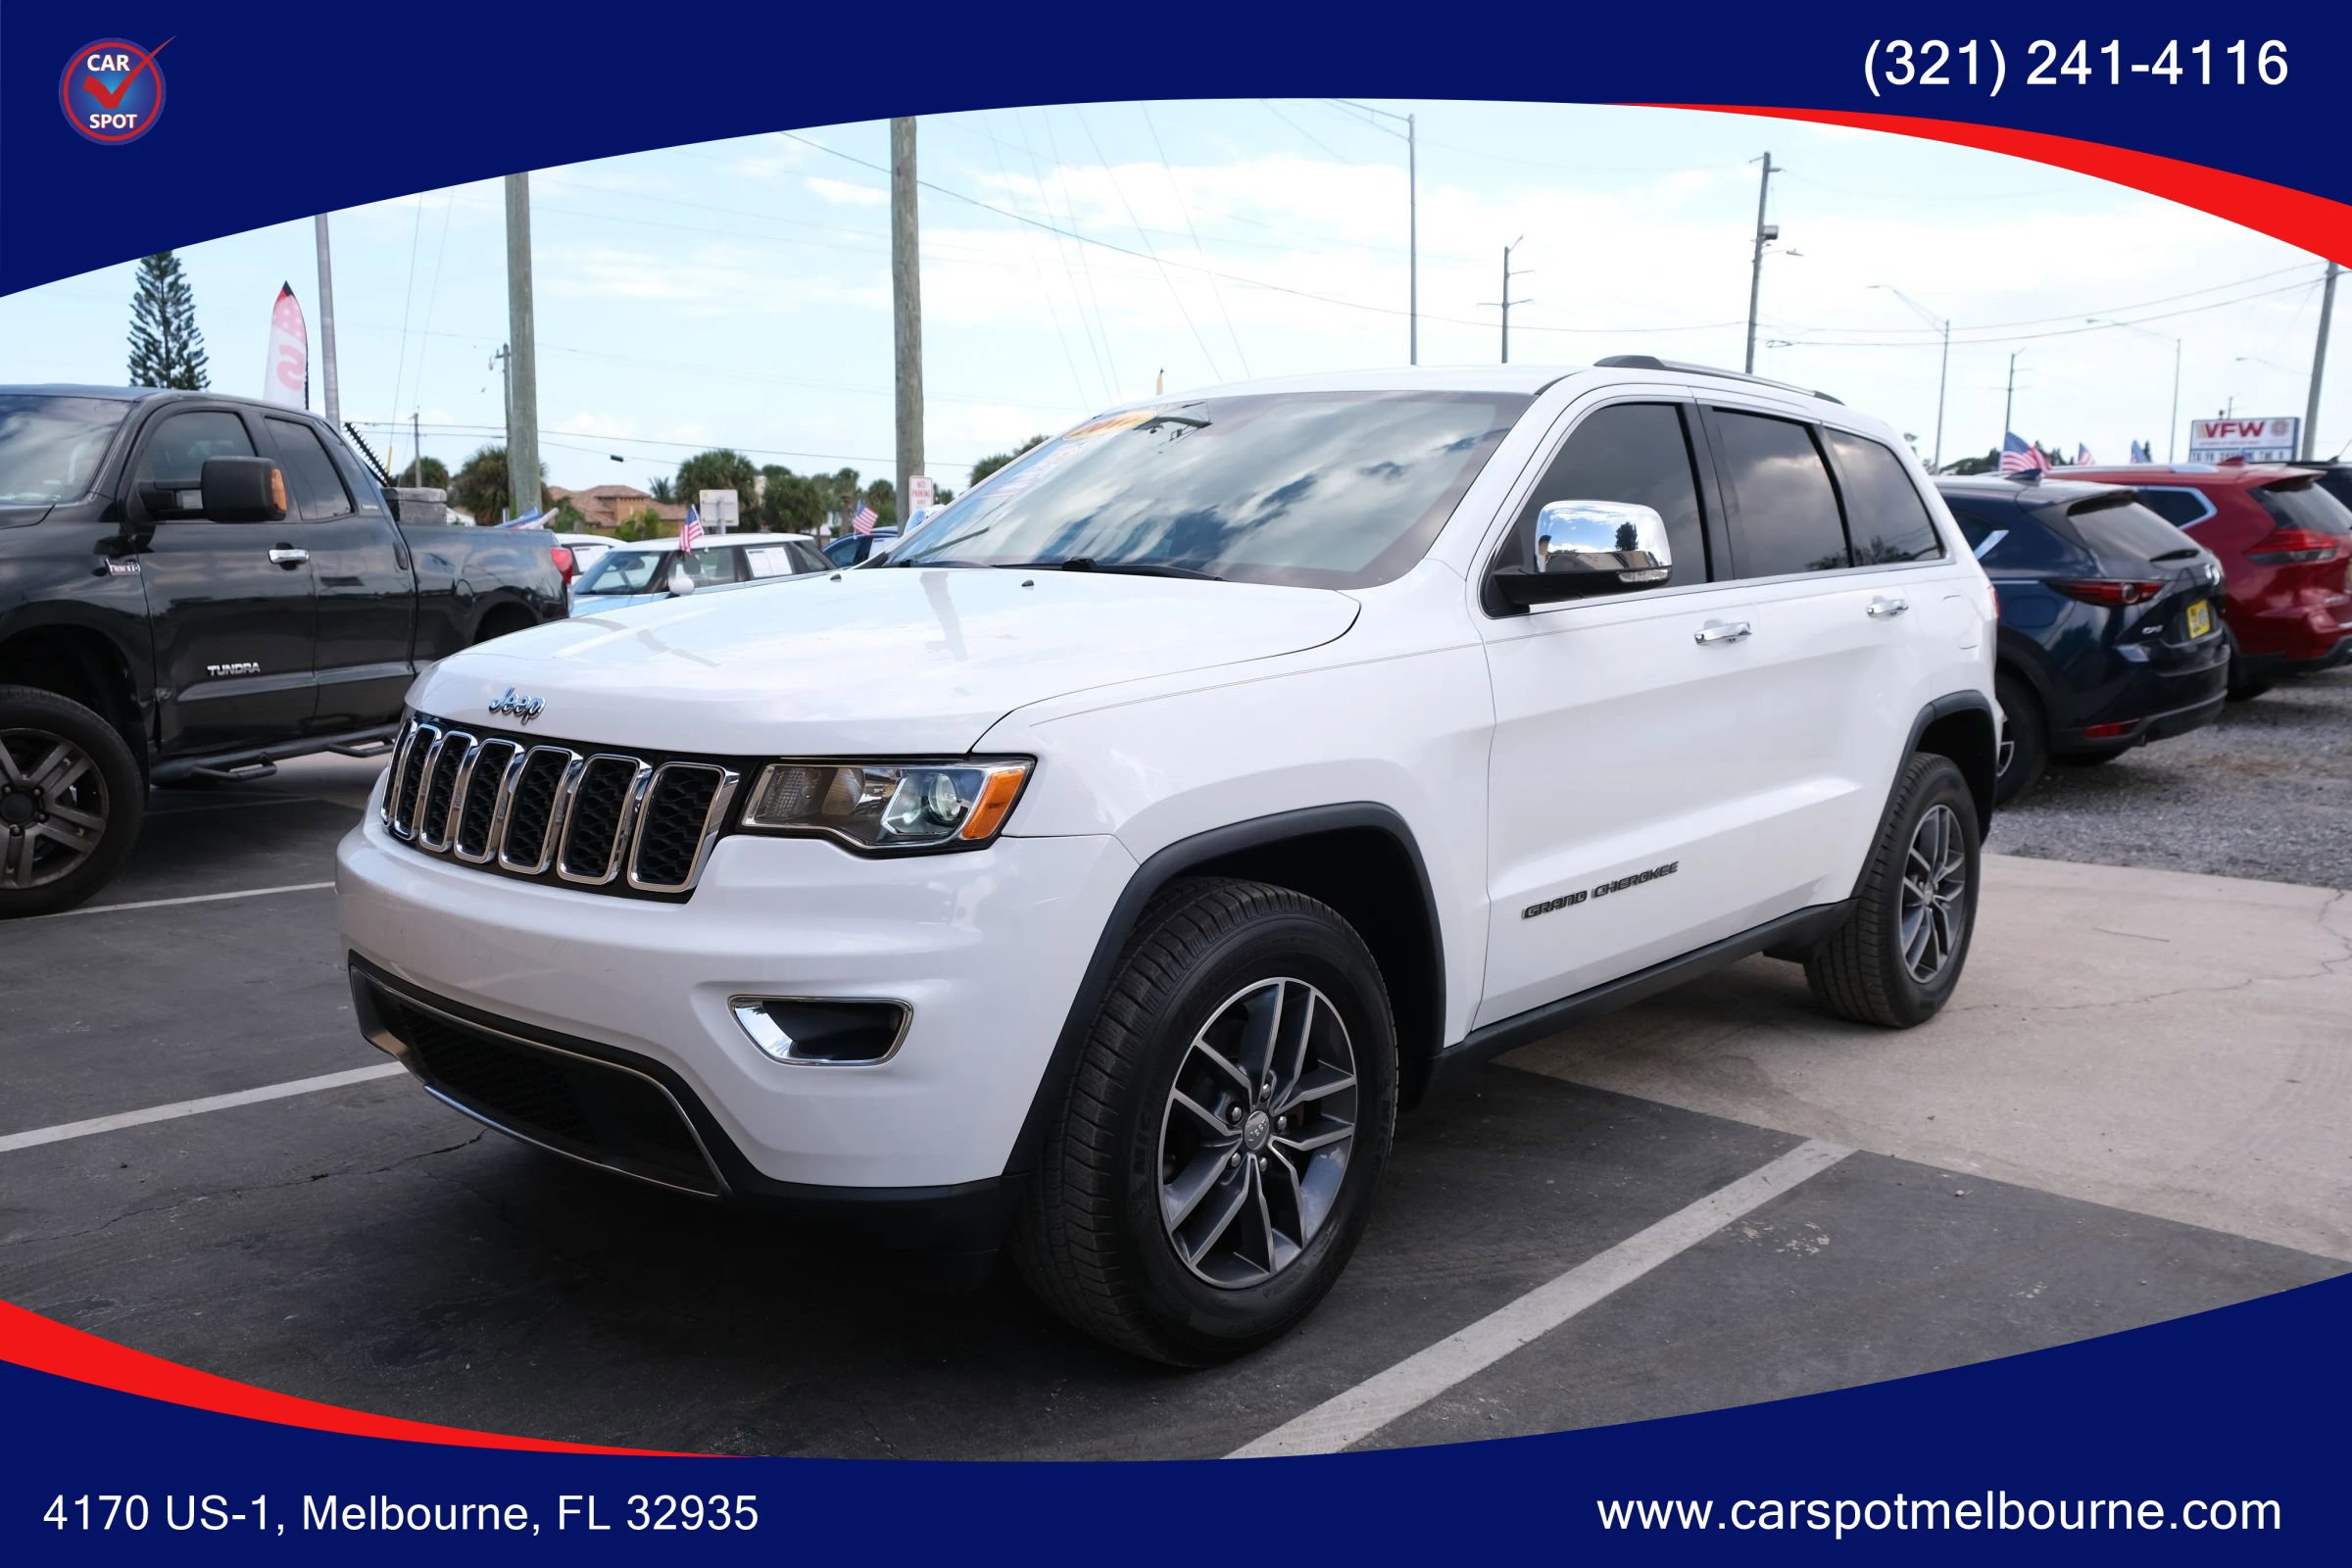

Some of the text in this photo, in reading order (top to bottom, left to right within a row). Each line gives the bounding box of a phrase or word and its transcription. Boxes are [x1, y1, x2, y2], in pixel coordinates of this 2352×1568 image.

[2205, 421, 2266, 438] VFW
[207, 662, 261, 677] TUNDRA
[488, 685, 547, 725] Jeep
[1521, 860, 1679, 919] GRAND CHEROKEE
